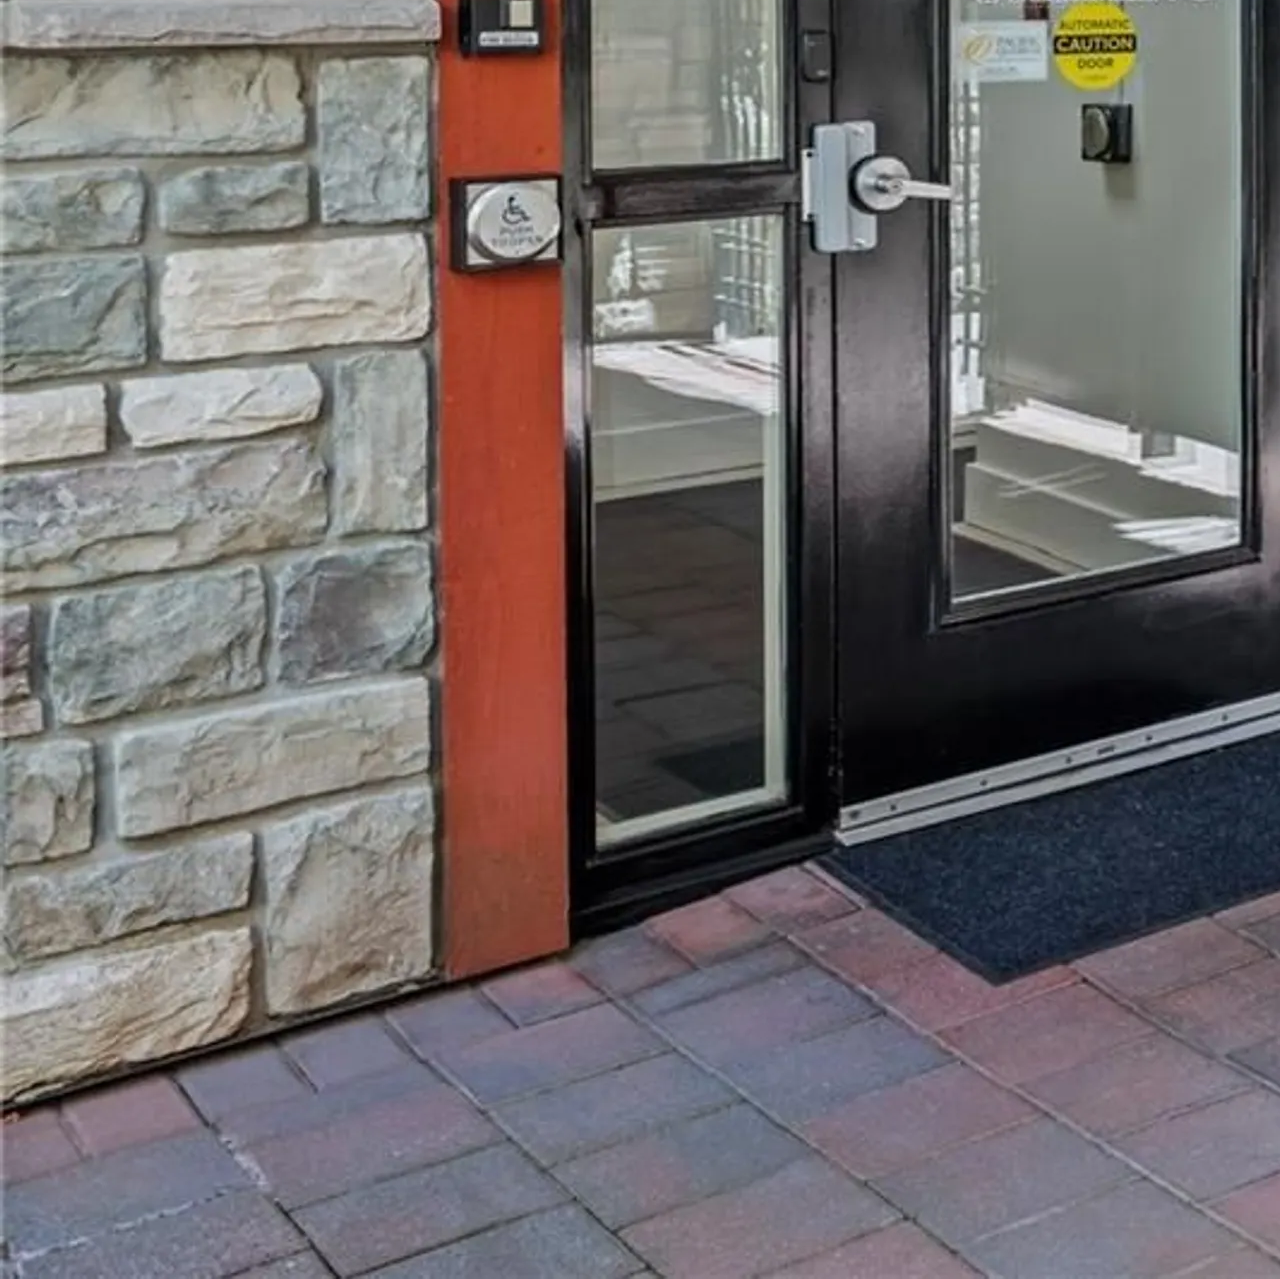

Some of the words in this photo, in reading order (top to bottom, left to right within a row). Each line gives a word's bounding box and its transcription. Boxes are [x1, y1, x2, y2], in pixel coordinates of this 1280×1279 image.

[1059, 20, 1131, 30] AUTOMATIC
[1055, 37, 1133, 52] CAUTION
[1077, 58, 1114, 69] DOOR
